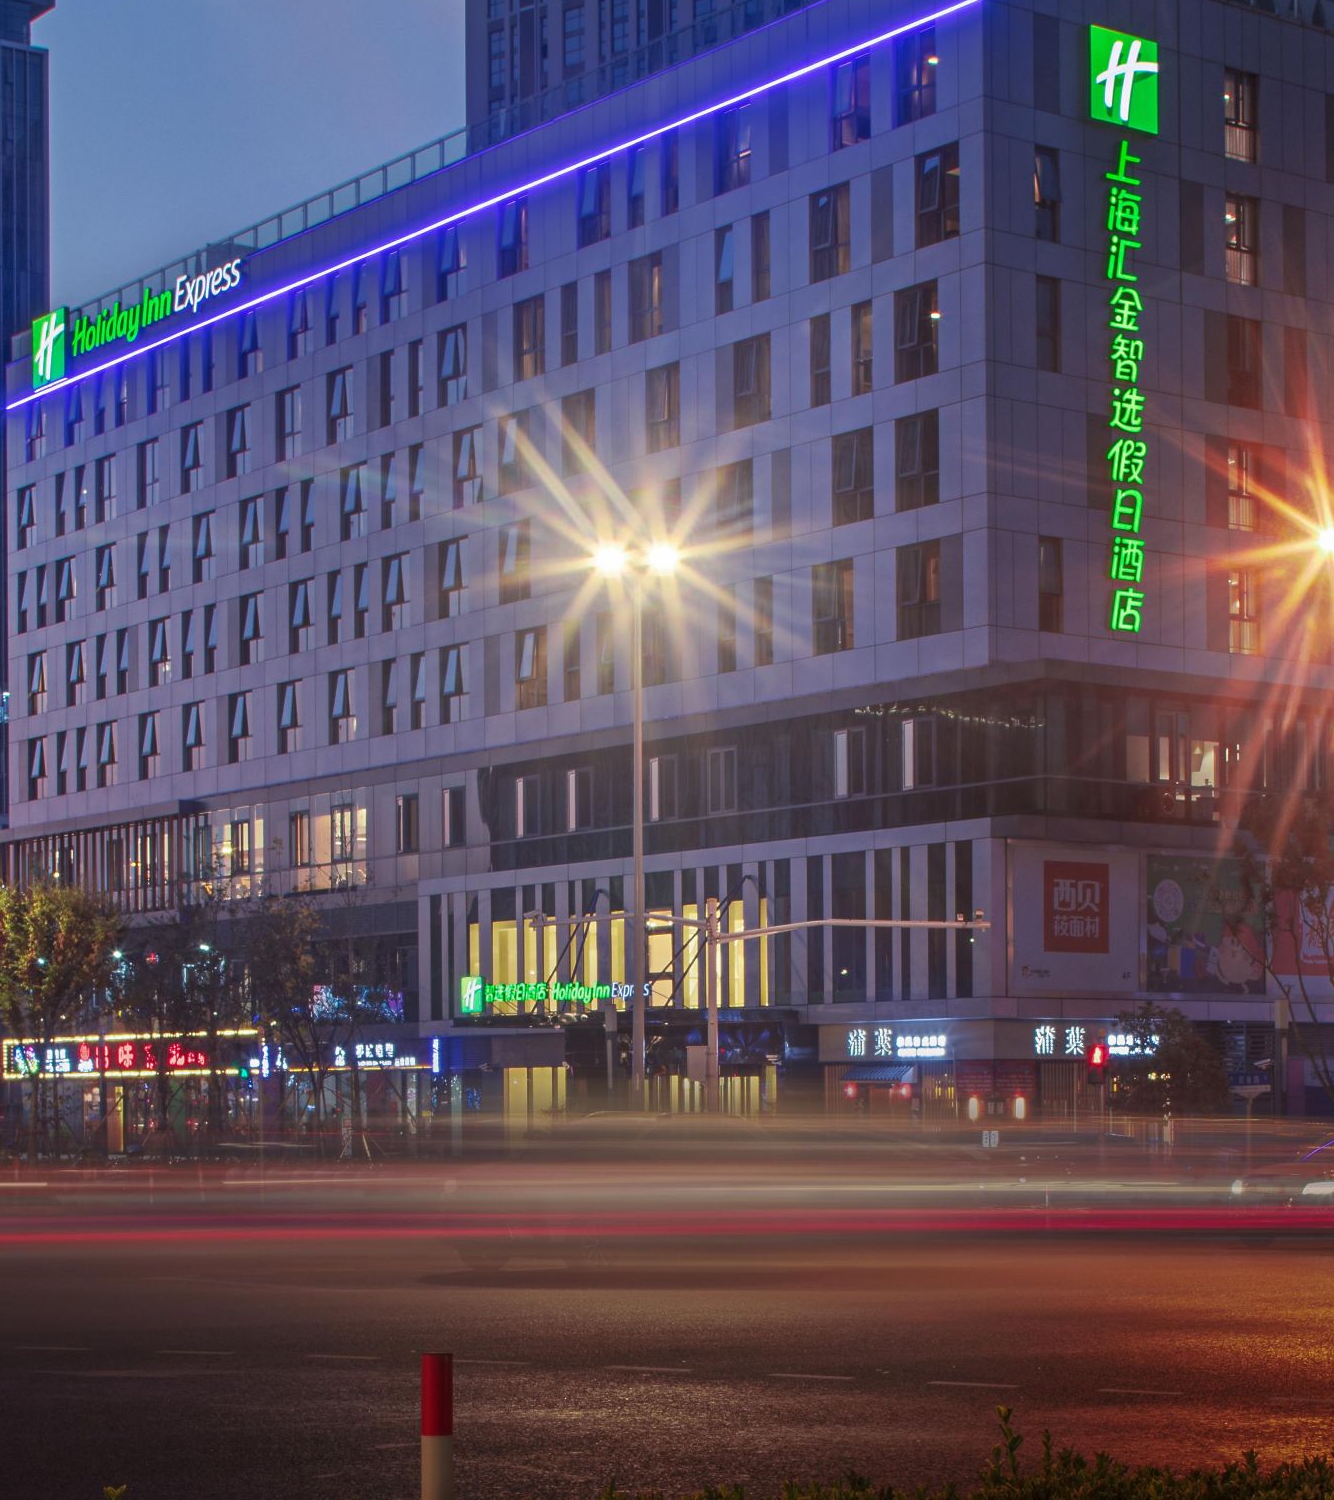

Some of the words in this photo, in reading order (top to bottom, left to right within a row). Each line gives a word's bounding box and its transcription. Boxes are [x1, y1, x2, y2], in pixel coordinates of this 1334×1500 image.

[174, 258, 241, 313] Express
[1105, 139, 1148, 634] 上海汇金智选假日酒店
[1053, 878, 1101, 912] 西贝
[1053, 916, 1100, 938] 莜面村
[484, 983, 548, 1003] 智选假日酒店
[611, 982, 650, 1001] Exprs
